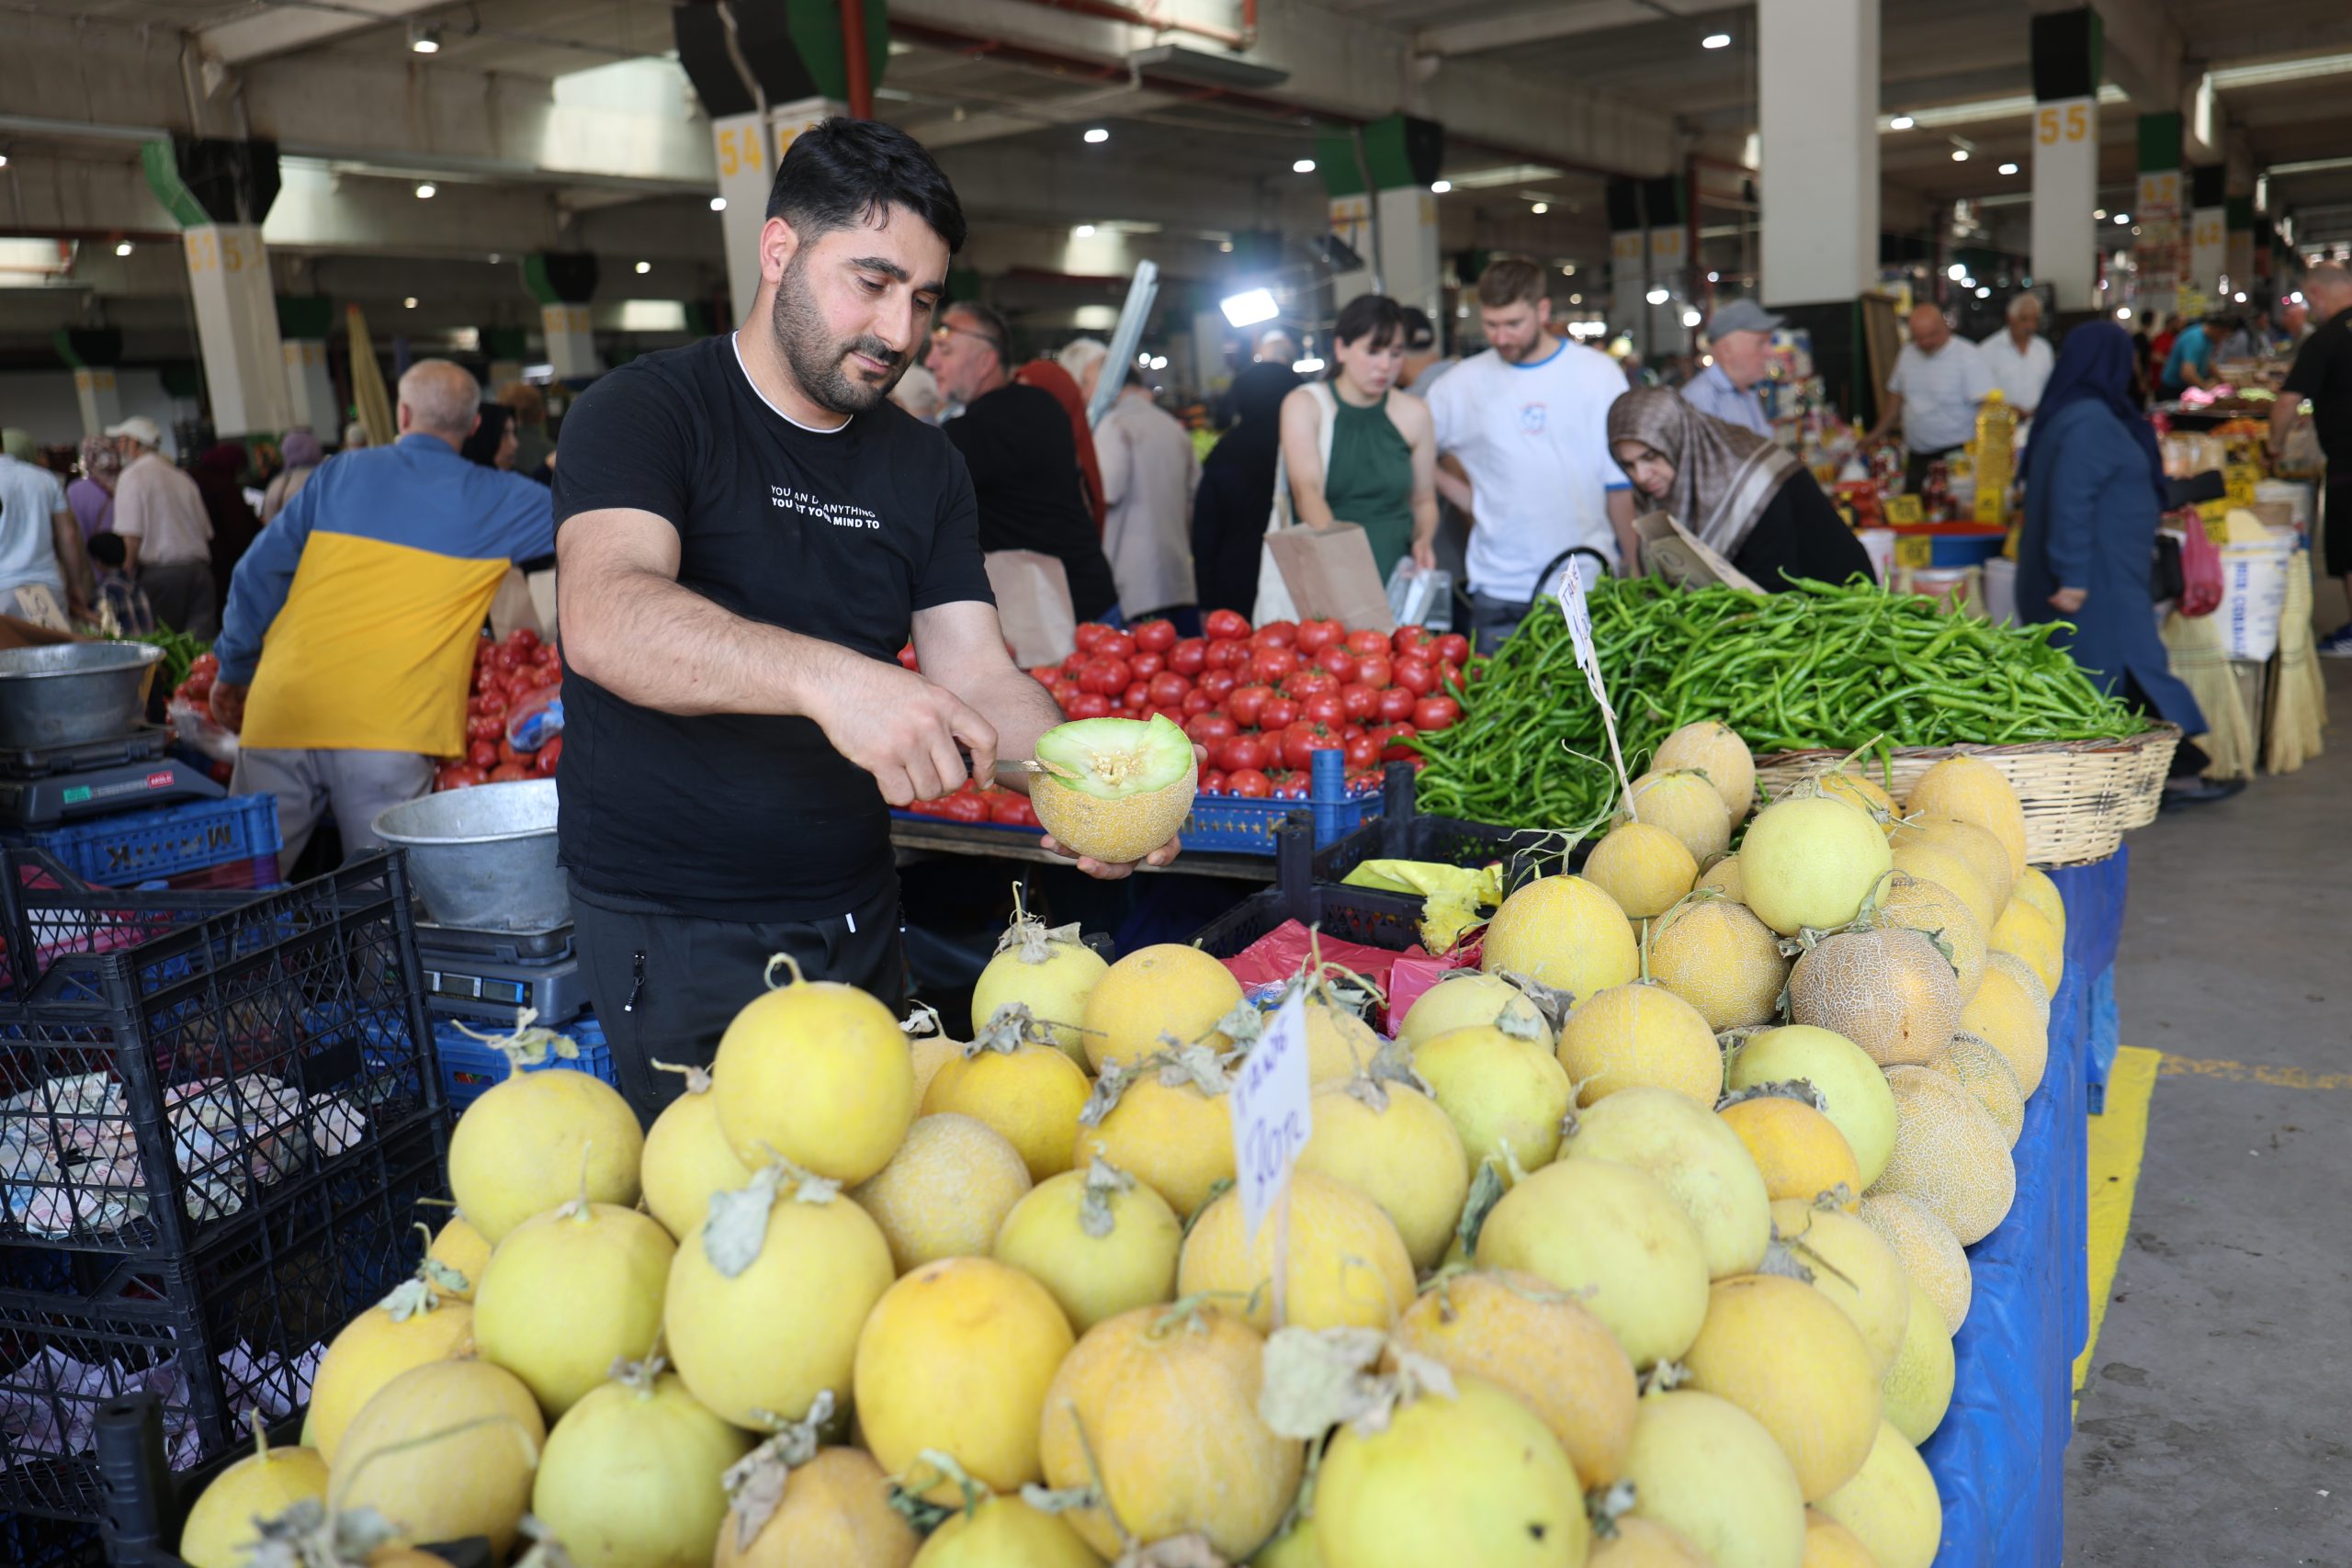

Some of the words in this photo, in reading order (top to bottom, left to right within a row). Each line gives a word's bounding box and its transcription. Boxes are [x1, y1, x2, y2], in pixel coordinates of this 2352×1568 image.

[2039, 103, 2087, 145] 55
[718, 124, 763, 176] 54
[771, 484, 791, 497] YOU
[822, 503, 876, 518] ANYTHING
[772, 497, 793, 508] YOU
[832, 516, 864, 529] MIND
[865, 519, 880, 530] TO
